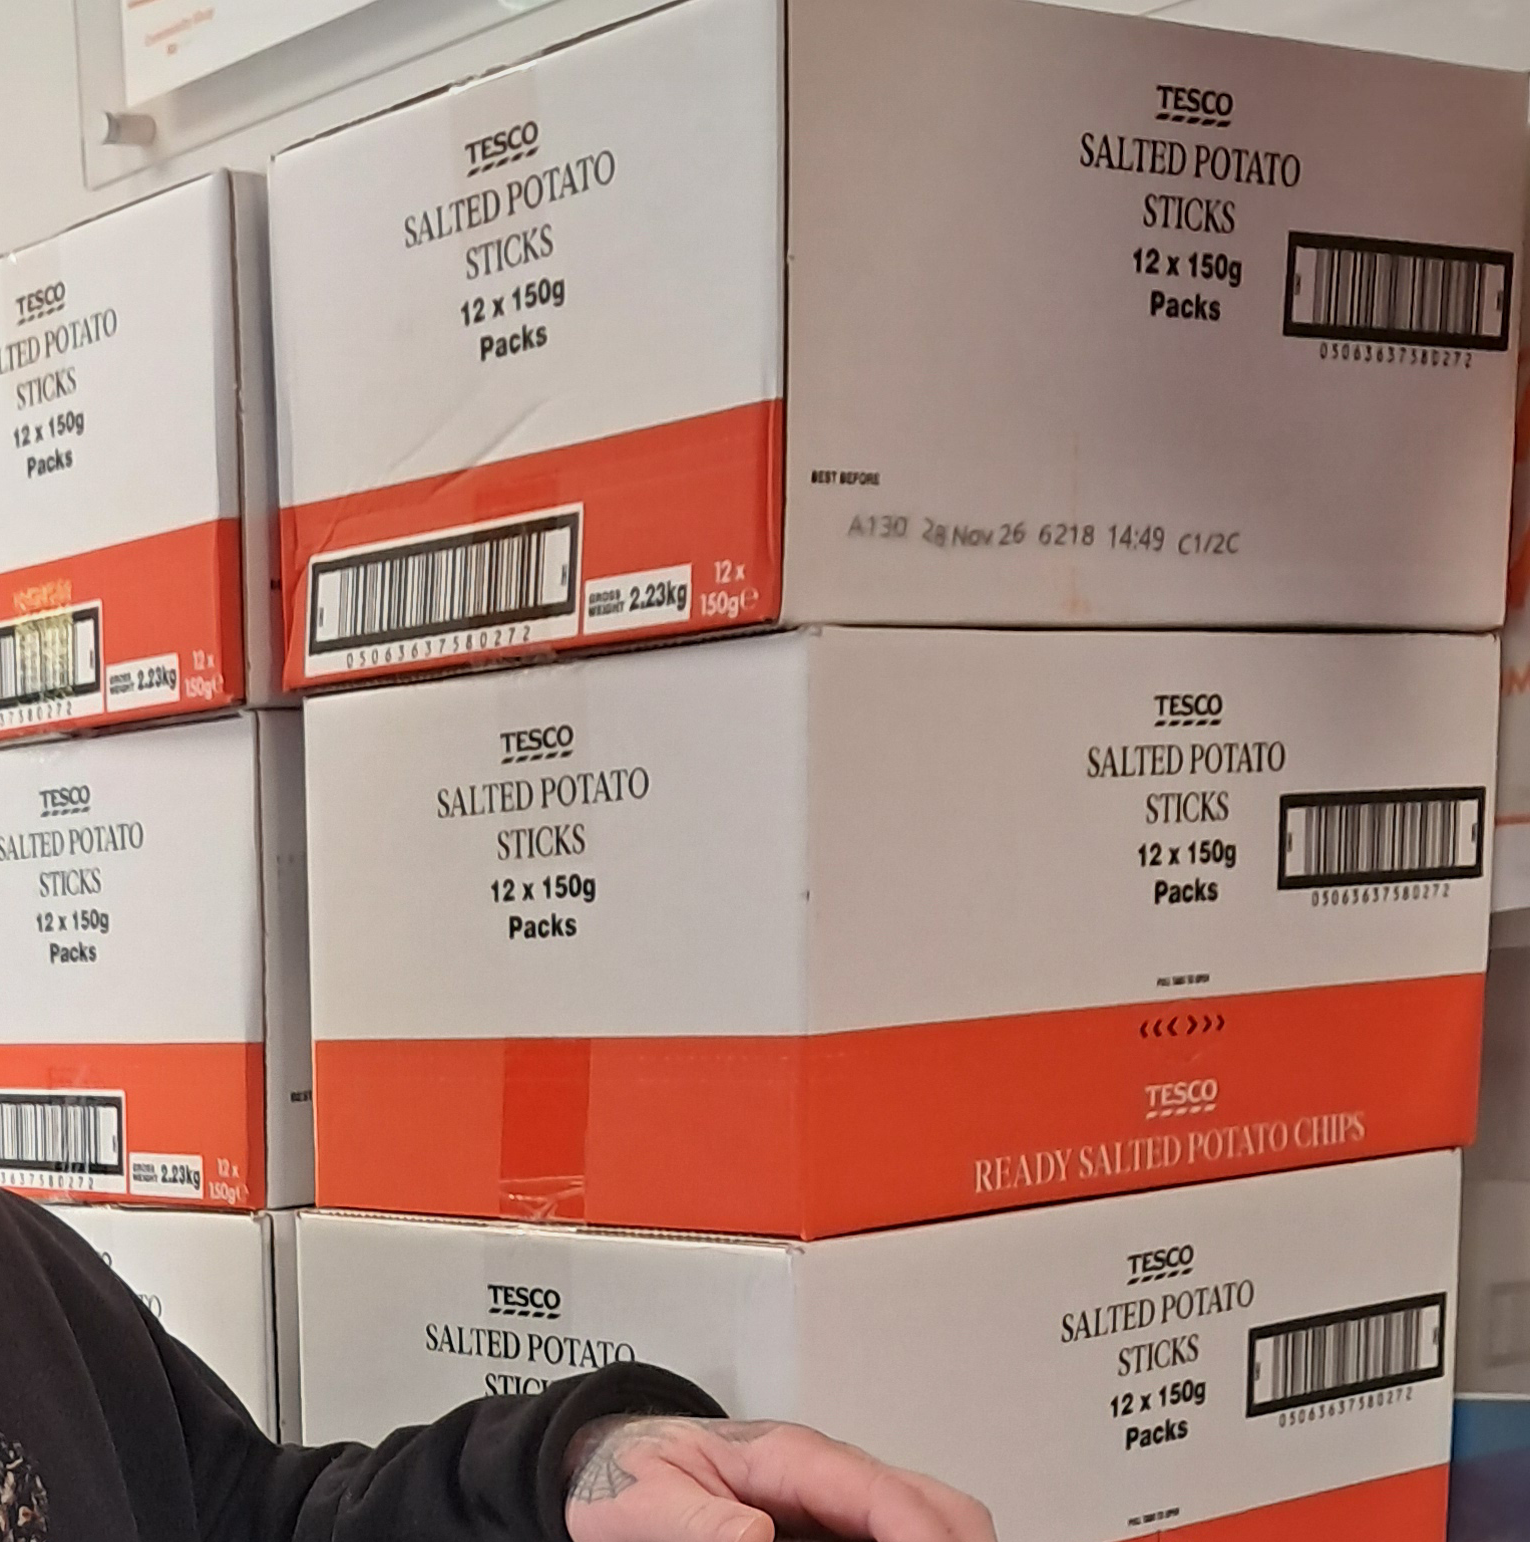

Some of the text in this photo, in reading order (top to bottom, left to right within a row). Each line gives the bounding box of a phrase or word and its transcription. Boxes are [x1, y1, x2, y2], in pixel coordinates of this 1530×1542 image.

[1156, 84, 1234, 118] TESCO
[465, 121, 539, 166] TESCO
[1079, 132, 1301, 189] SALTED POTATO
[404, 148, 617, 249] SALTED POTATO
[1142, 193, 1237, 235] STICKS
[465, 223, 555, 282] STICKS
[1132, 248, 1243, 288] 12 x 150g
[15, 281, 66, 316] TESCO
[460, 277, 566, 328] 12 x 150g
[1149, 290, 1221, 323] Packs
[43, 308, 118, 356] POTATO
[479, 323, 548, 362] Packs
[16, 368, 77, 411] STICKS
[811, 470, 880, 486] BEST BEFORE
[998, 521, 1026, 546] 26
[1038, 523, 1095, 546] 6218
[1108, 524, 1165, 551] 14:49
[1177, 532, 1240, 555] C1/2C
[629, 580, 688, 612] 2.23kg
[1154, 694, 1223, 717] TESCO
[500, 725, 574, 754] TESCO
[1087, 741, 1286, 779] SALTED POTATO
[39, 785, 91, 809] TESCO
[437, 767, 649, 819] SALTED POTATO
[1146, 791, 1229, 825] STICKS
[69, 822, 144, 855] POTATO
[496, 823, 586, 862] STICKS
[39, 868, 101, 896] STICKS
[1145, 1079, 1218, 1107] TESCO
[973, 1111, 1366, 1194] READY SALTED POTATO CHIPS
[1127, 1245, 1194, 1275] TESCO
[488, 1284, 561, 1310] TESCO
[1061, 1279, 1255, 1344] SALTED POTATO
[425, 1323, 635, 1369] SALTED POTATO
[1117, 1334, 1199, 1377] STICKS
